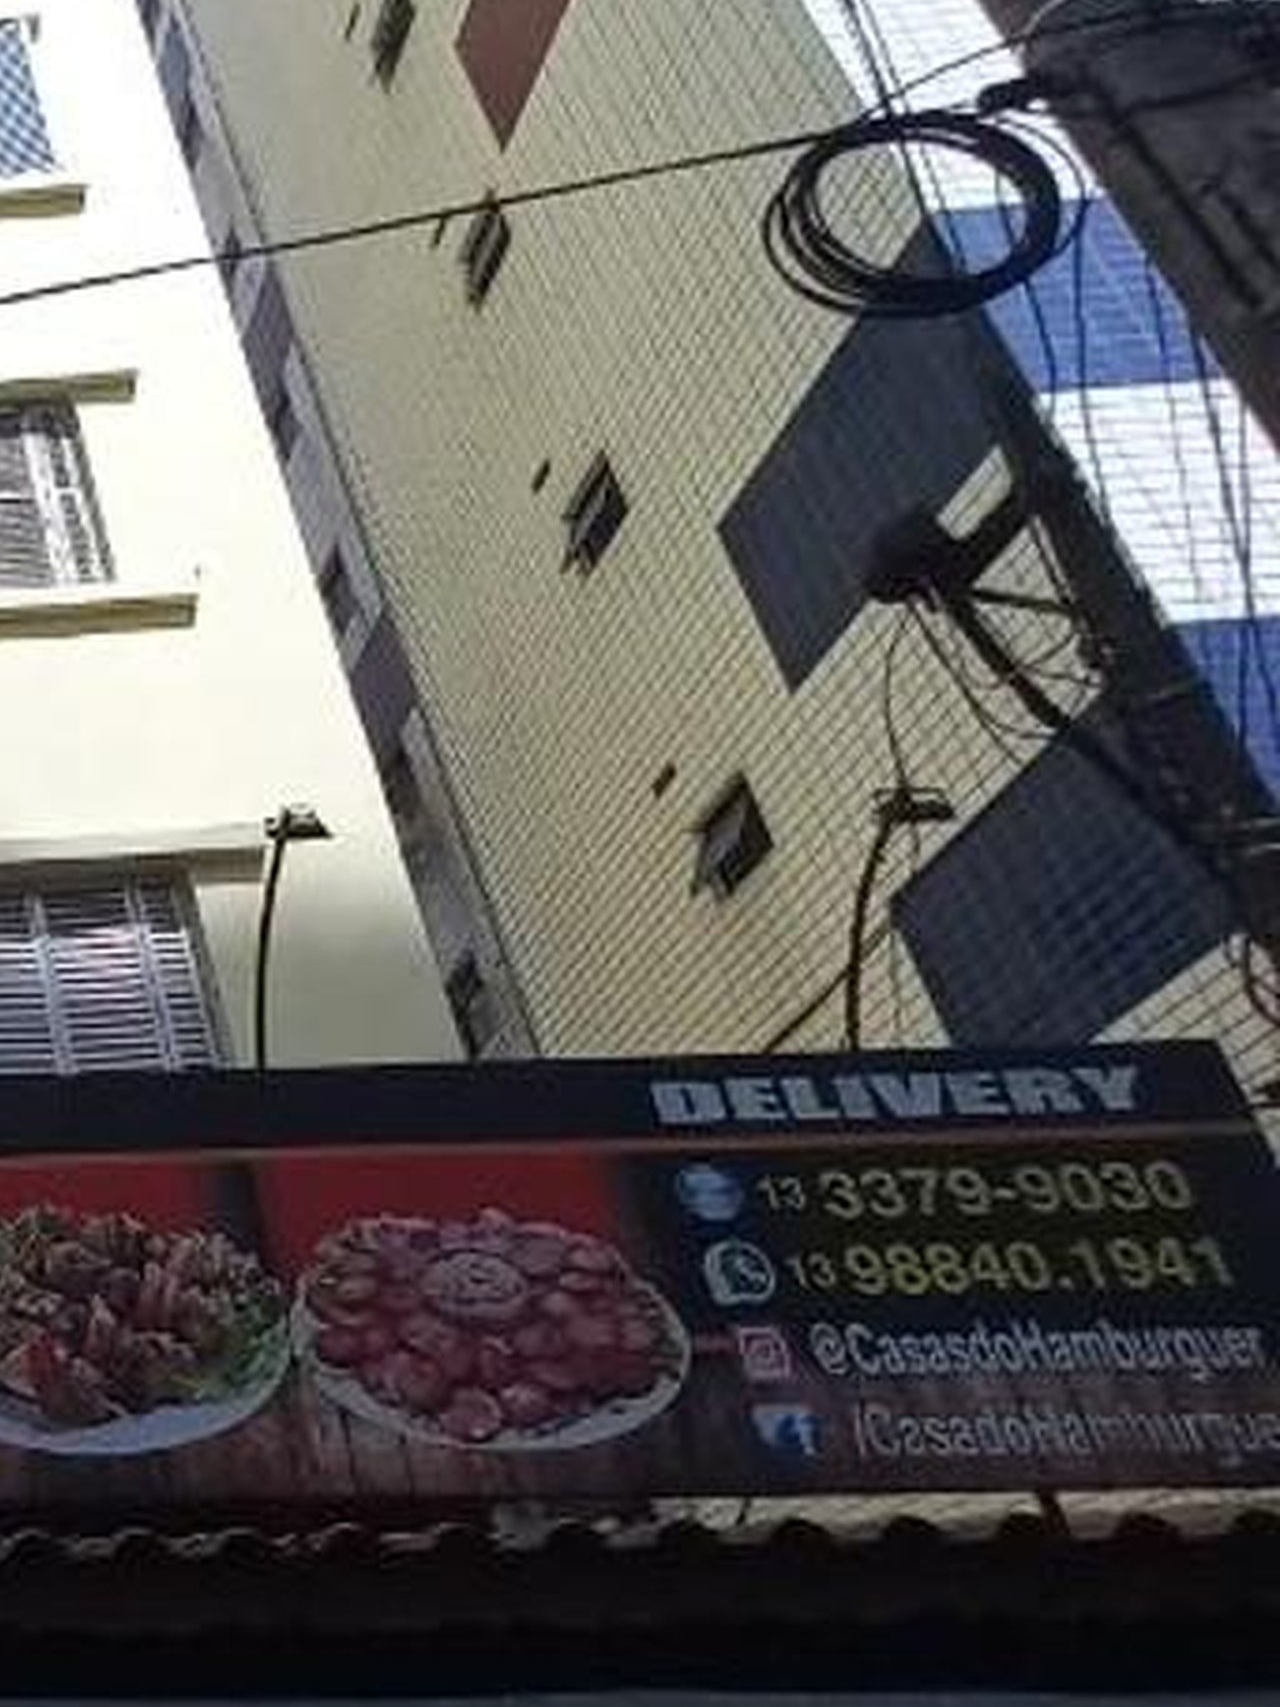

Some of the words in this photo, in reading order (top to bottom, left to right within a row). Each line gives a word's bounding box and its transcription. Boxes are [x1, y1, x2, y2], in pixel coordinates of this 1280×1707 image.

[649, 1066, 1138, 1124] DELIVERY
[757, 1175, 806, 1210] 13
[819, 1160, 1195, 1218] 3379-9030
[784, 1251, 837, 1290] 13
[844, 1235, 1235, 1295] 98840.1941
